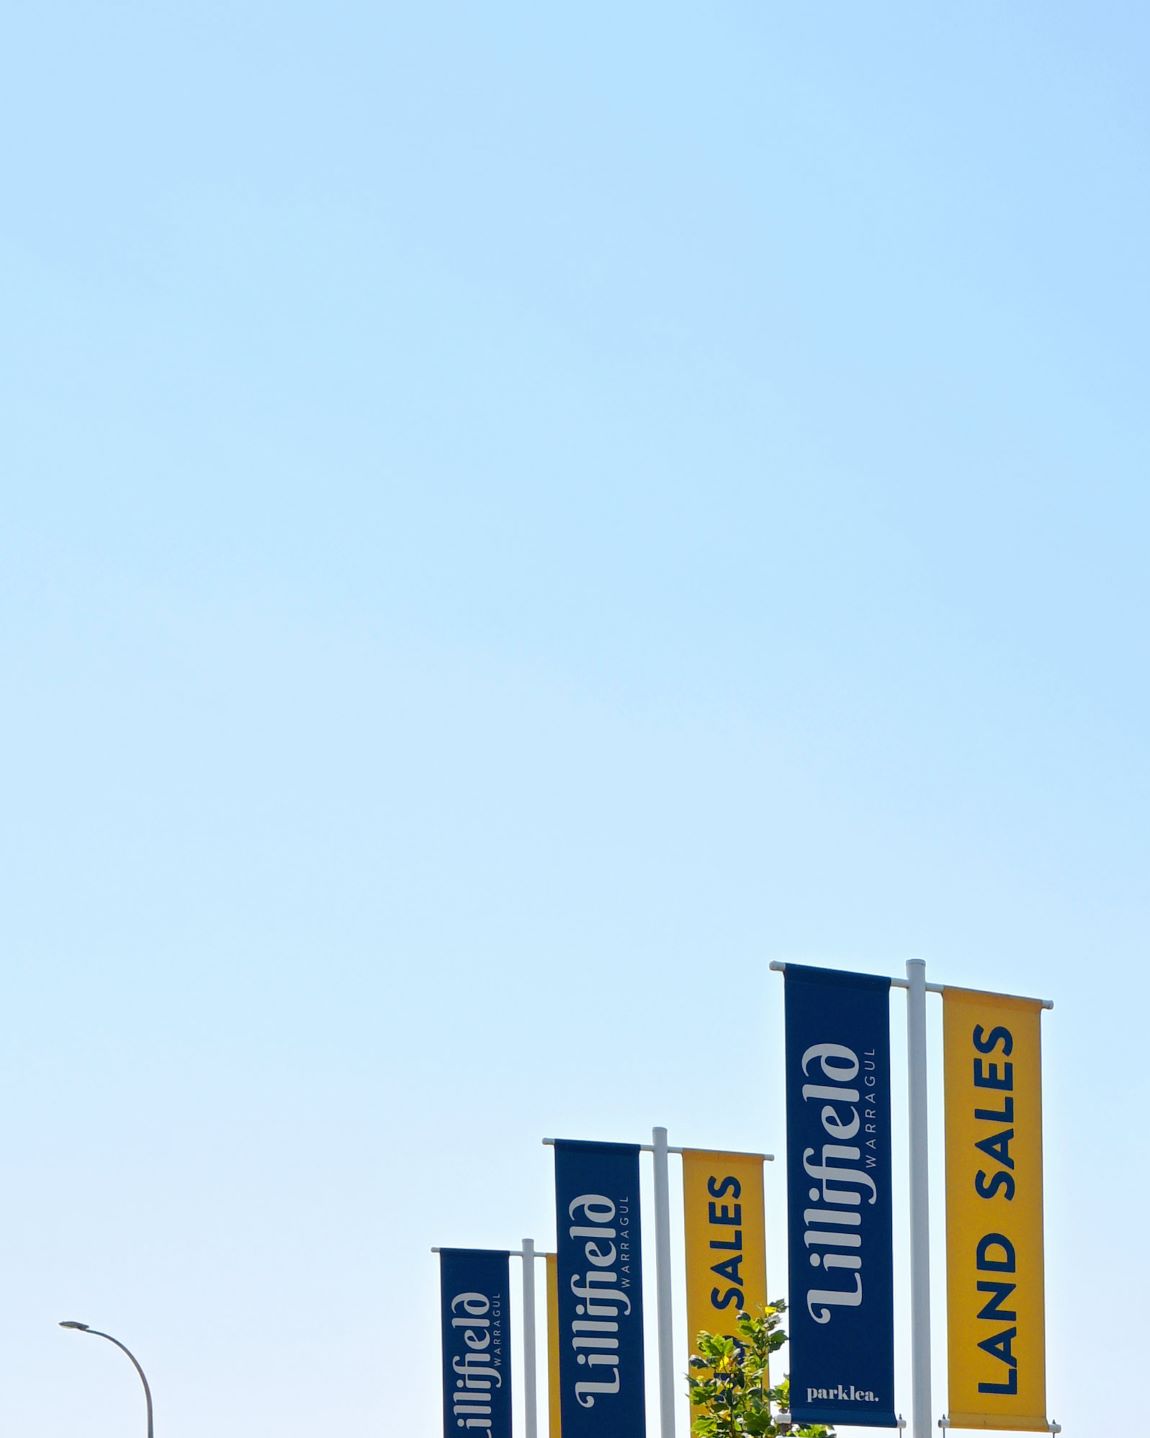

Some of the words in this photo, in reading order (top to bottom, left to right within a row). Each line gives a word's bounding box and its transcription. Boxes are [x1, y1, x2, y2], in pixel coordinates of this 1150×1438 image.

[864, 1048, 877, 1169] WARRAGUL
[972, 1023, 1016, 1202] SALES
[619, 1196, 630, 1289] WARRAGUL
[706, 1175, 746, 1311] SALES
[801, 1043, 877, 1324] Lillifield
[492, 1292, 502, 1367] WARRAGUL
[568, 1194, 632, 1409] Lillifield
[976, 1232, 1018, 1396] LAND
[807, 1384, 879, 1403] parklea.
